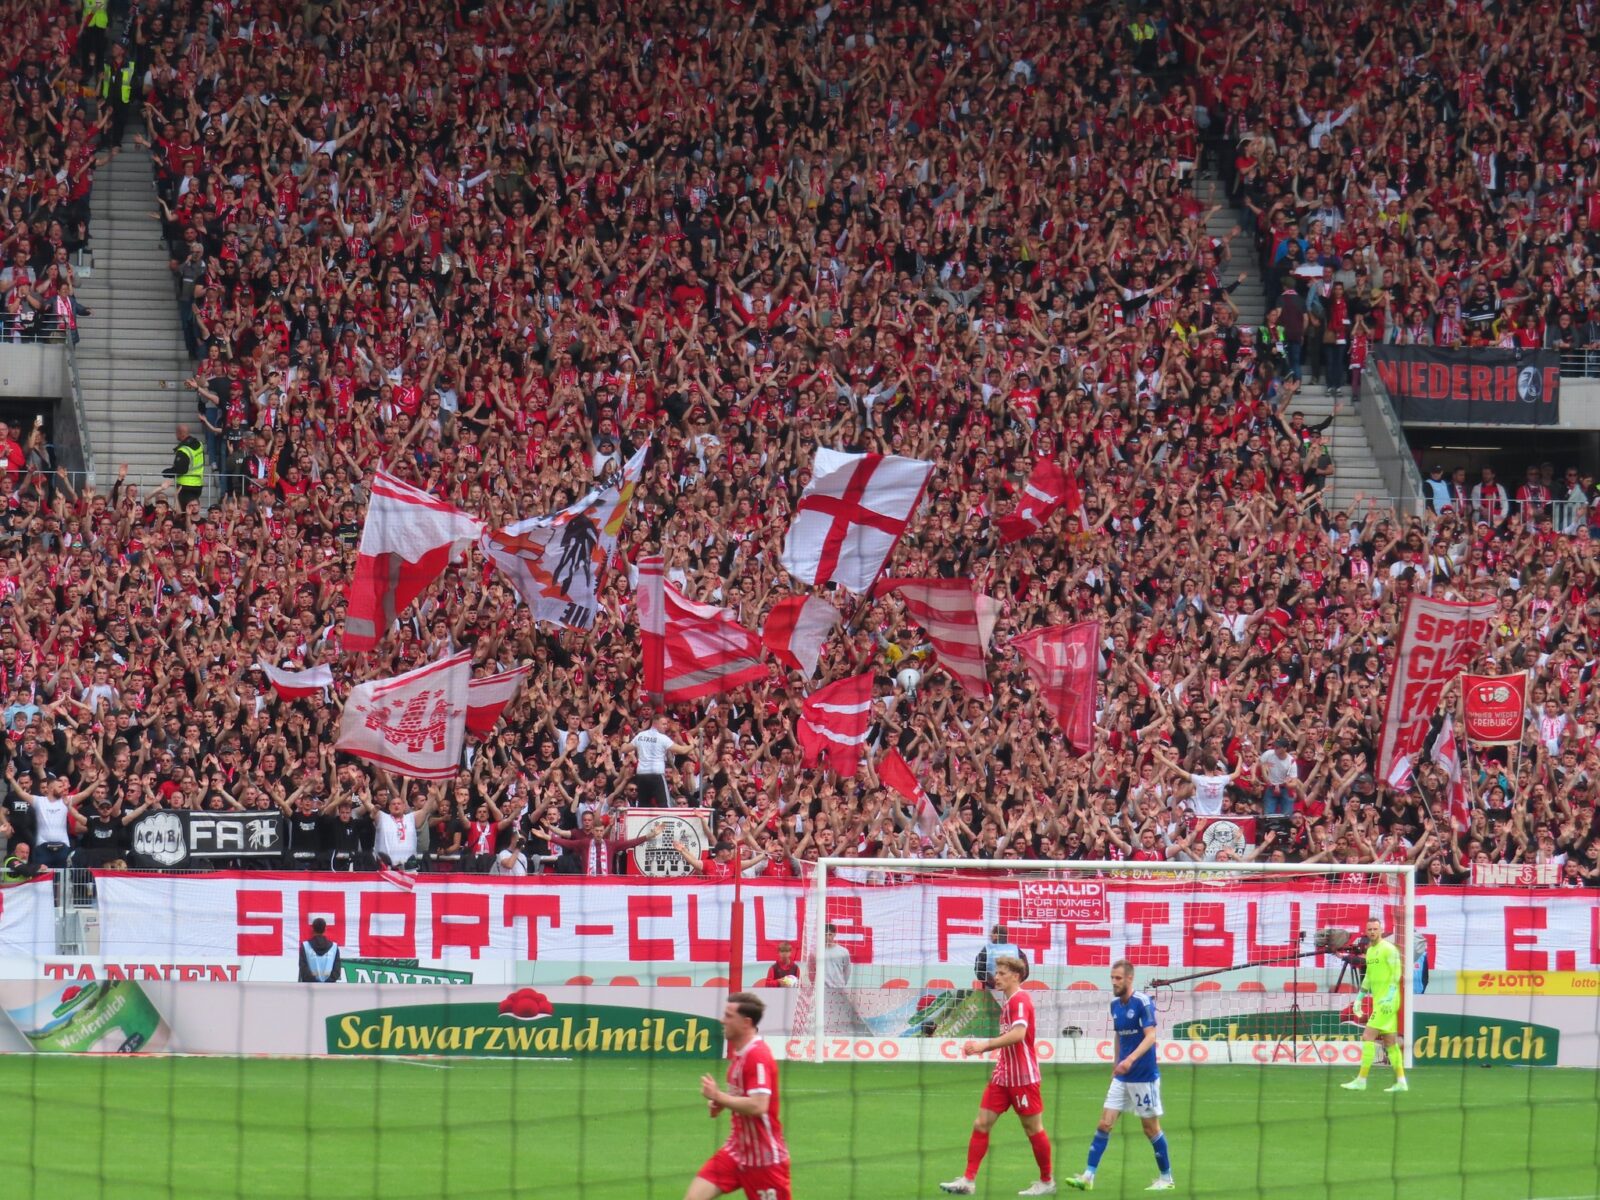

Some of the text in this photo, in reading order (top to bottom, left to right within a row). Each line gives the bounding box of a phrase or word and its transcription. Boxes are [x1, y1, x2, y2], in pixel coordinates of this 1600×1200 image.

[1473, 718, 1514, 727] FREIBURG
[136, 829, 177, 844] ACAB
[1025, 884, 1101, 896] KHALID
[1025, 896, 1101, 907] FÜR IMMER
[1036, 908, 1091, 918] BEI UNS
[1498, 975, 1545, 987] LOTTO
[337, 1014, 712, 1052] Schwarzwaldmilch
[1016, 1094, 1029, 1108] 14
[1135, 1093, 1151, 1107] 24
